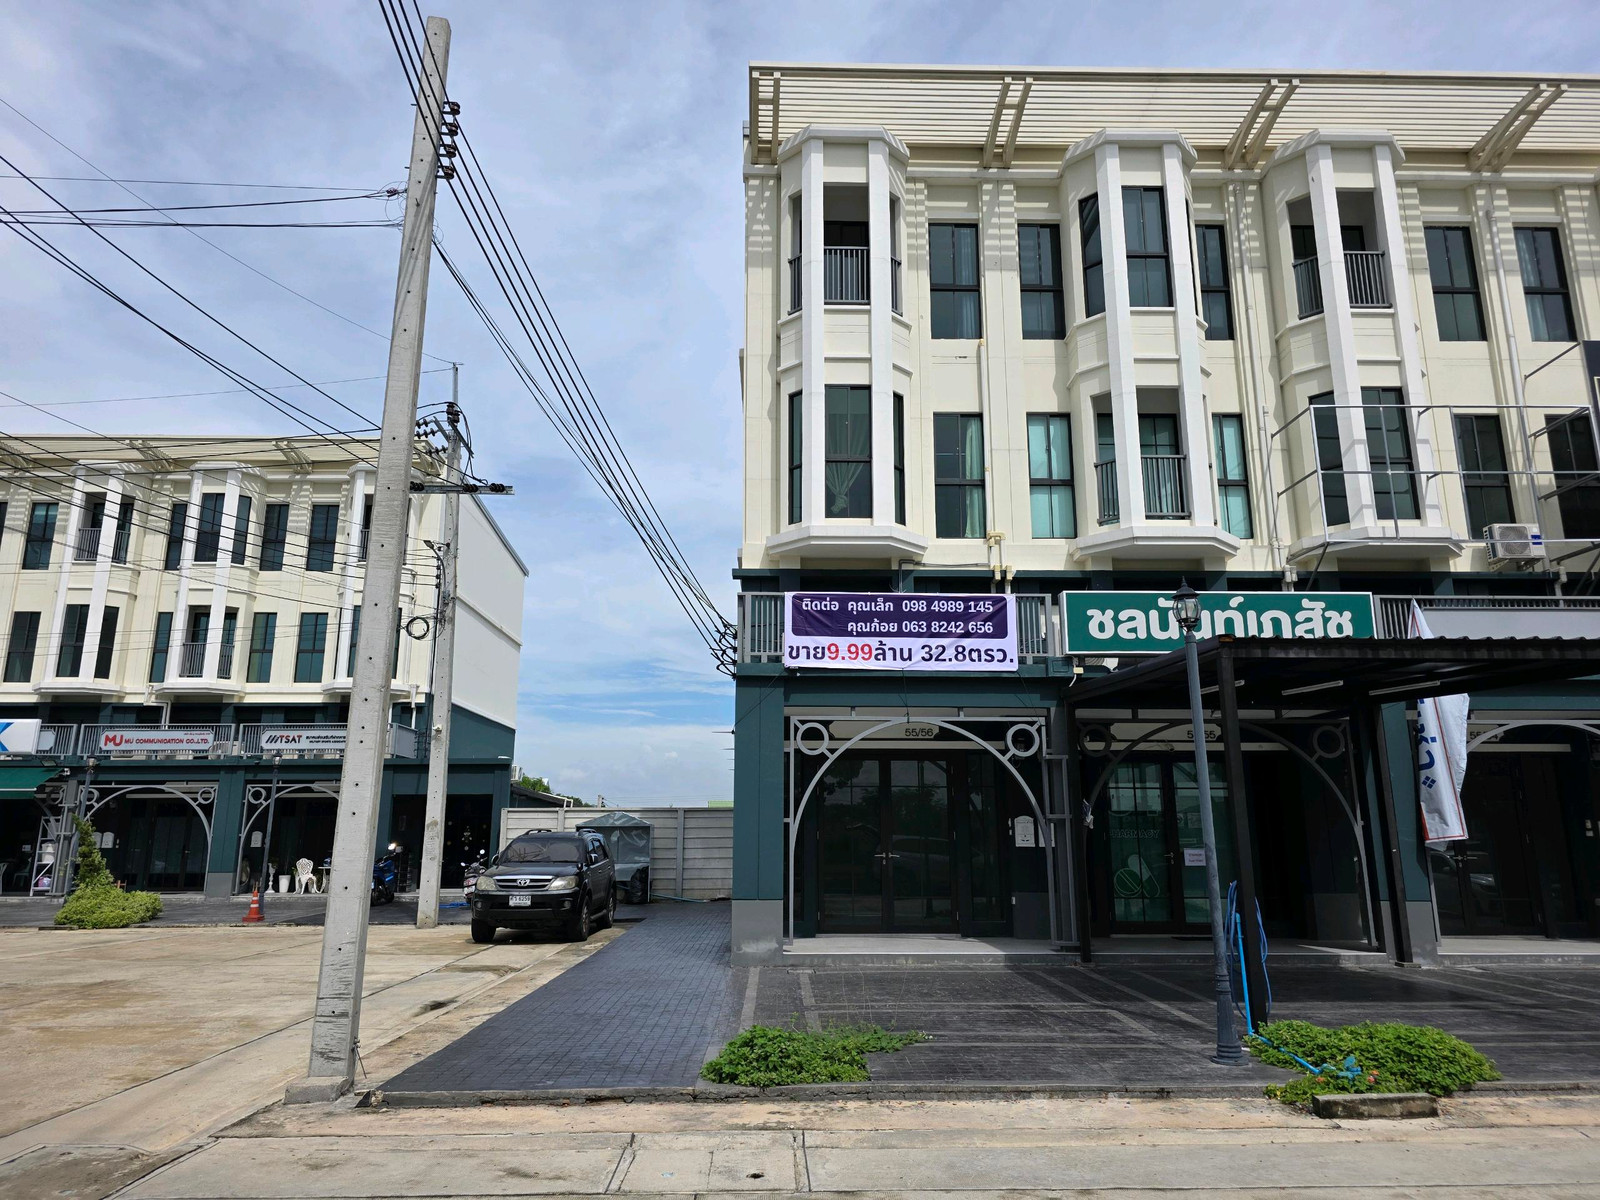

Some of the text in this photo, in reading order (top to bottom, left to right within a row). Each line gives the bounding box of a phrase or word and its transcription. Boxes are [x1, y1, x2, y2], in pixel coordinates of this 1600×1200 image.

[802, 597, 993, 615] ติดต่อ คุณเล็ก 098 4989 145
[847, 618, 993, 635] คุณก้อย 063 8242 656
[920, 644, 1014, 663] 32.8ตรว.
[104, 734, 124, 746] MU
[904, 728, 934, 737] 55/56
